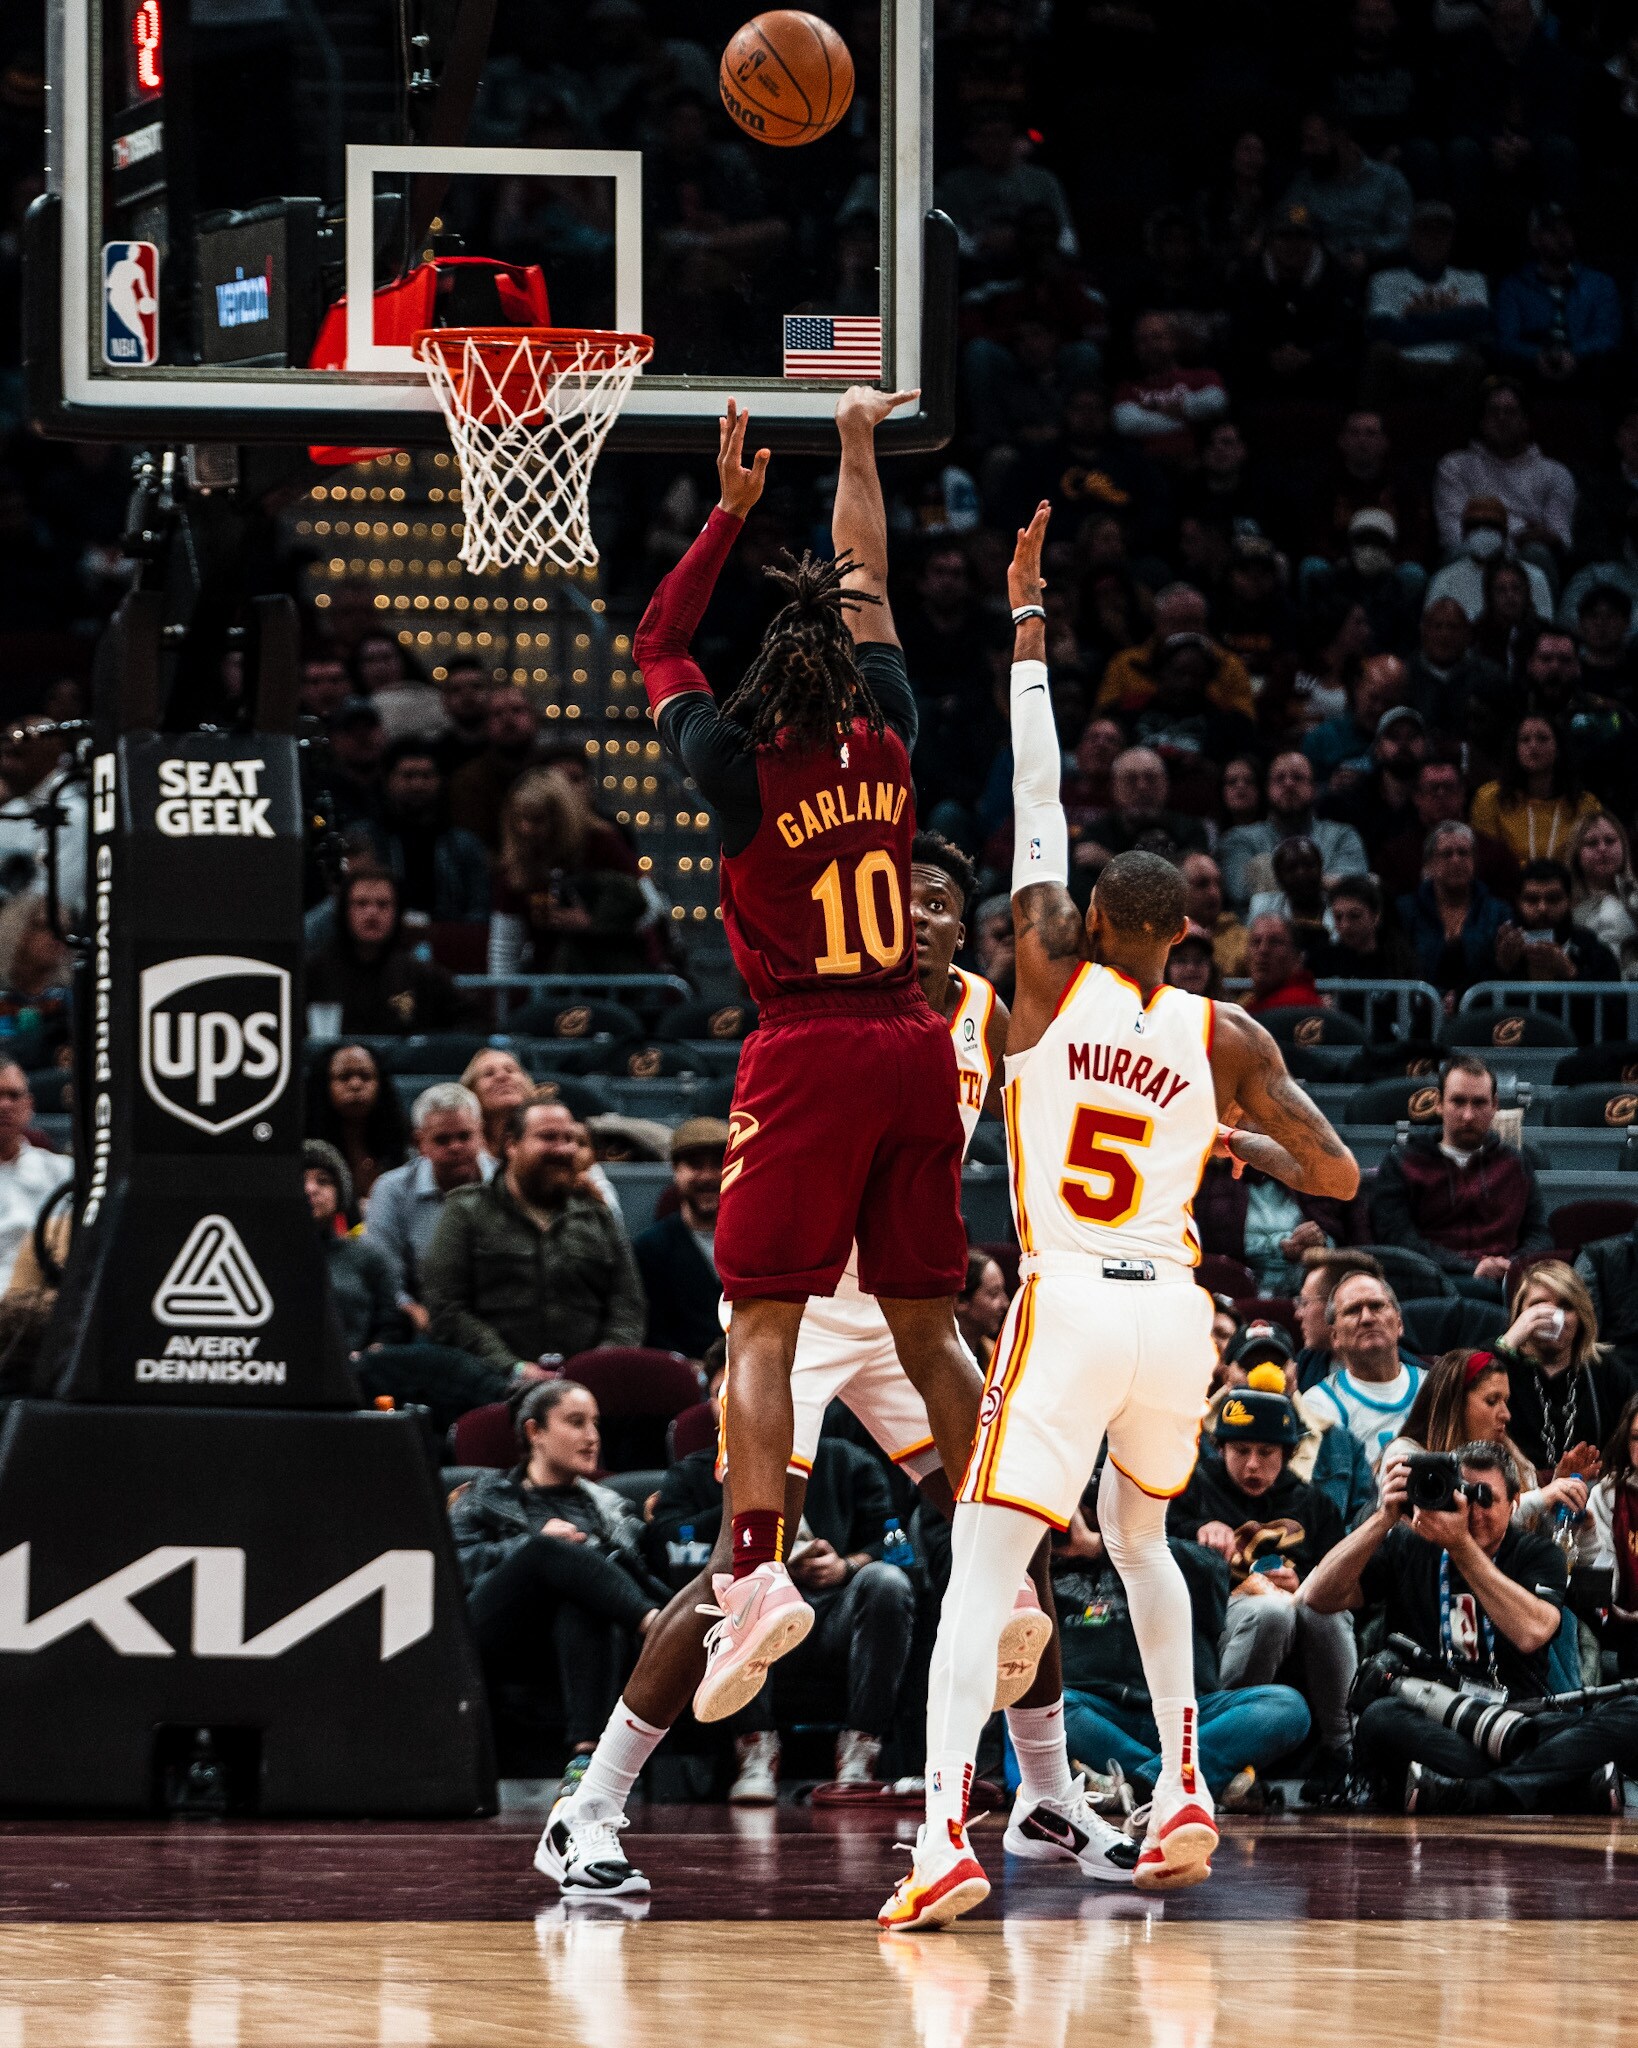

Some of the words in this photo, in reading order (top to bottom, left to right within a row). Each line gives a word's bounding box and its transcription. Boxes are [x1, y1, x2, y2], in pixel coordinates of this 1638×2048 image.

[158, 759, 266, 798] SEAT
[155, 798, 277, 839] GEEK
[777, 782, 907, 848] GARLAND
[811, 849, 904, 975] 10
[152, 1010, 280, 1106] ups
[1068, 1043, 1190, 1109] MURRAY
[1058, 1102, 1154, 1228] 5
[135, 1358, 288, 1385] DENNISON
[162, 1335, 261, 1359] AVERY
[0, 1541, 435, 1662] KIA
